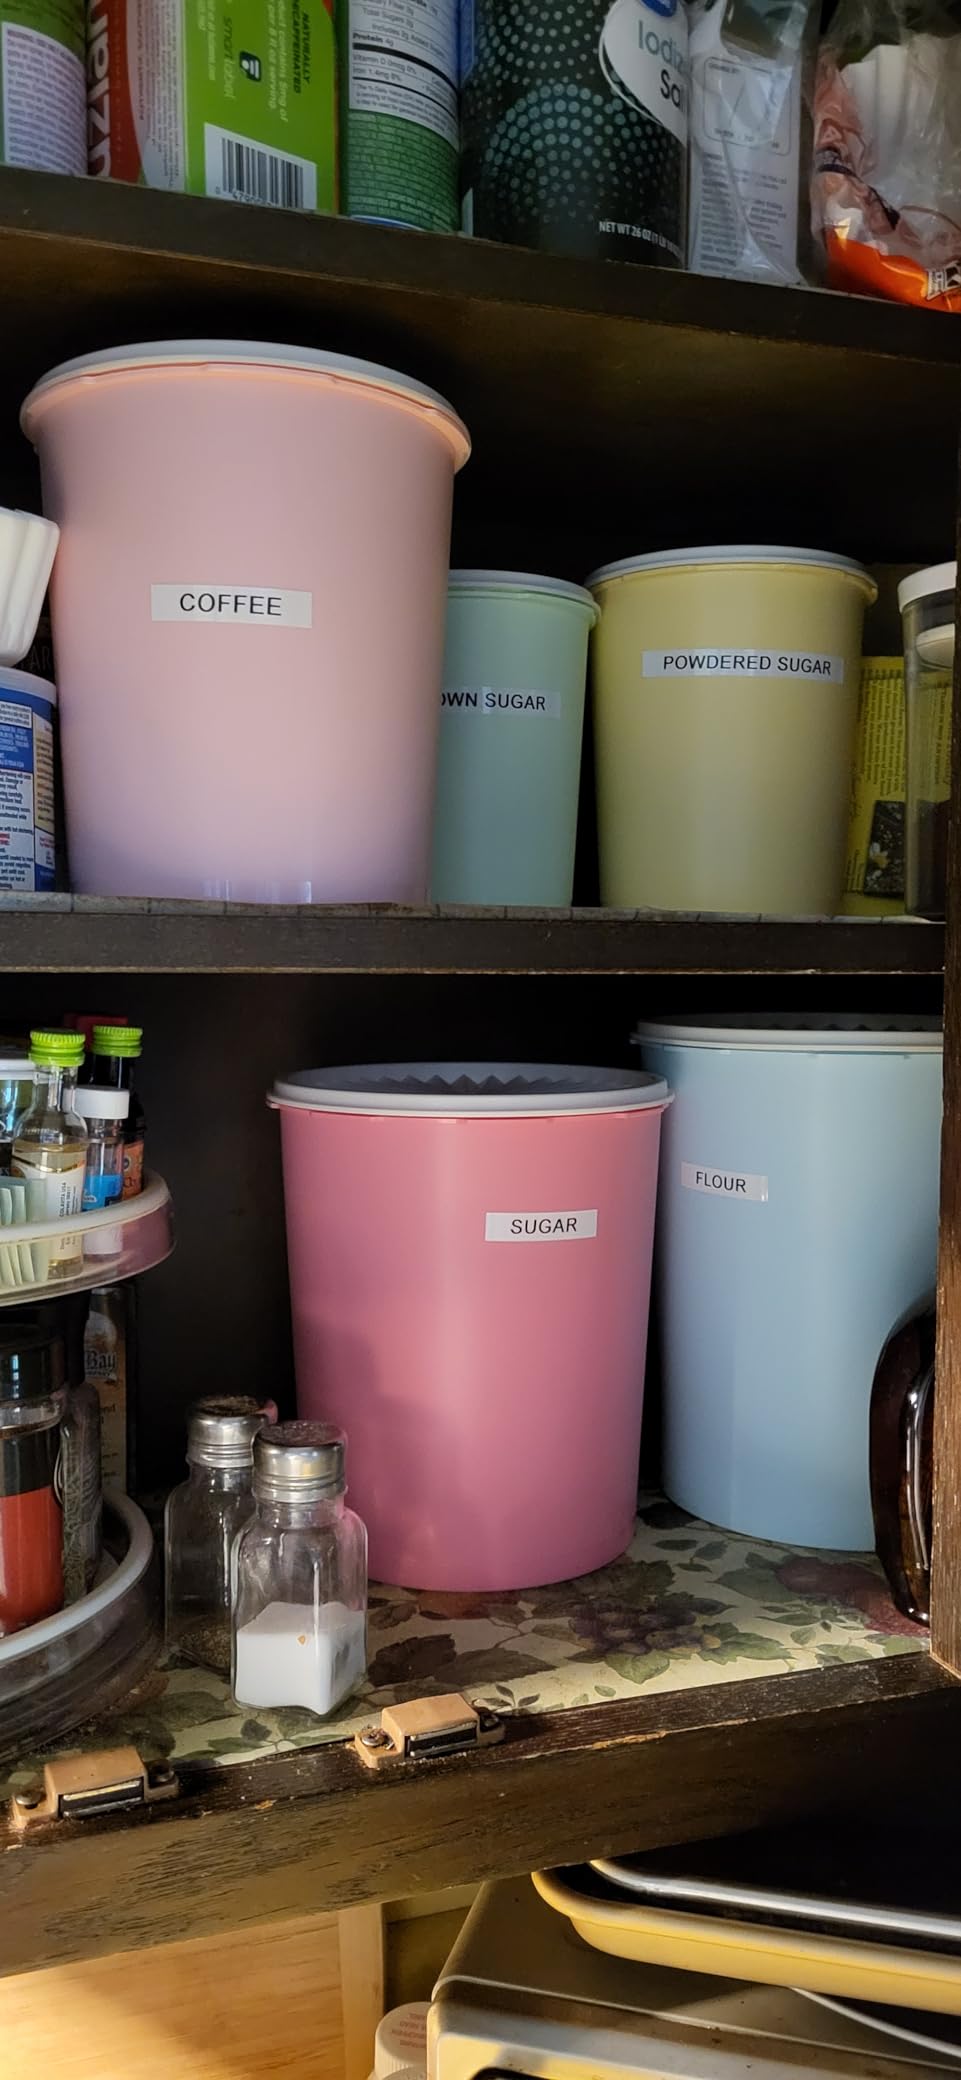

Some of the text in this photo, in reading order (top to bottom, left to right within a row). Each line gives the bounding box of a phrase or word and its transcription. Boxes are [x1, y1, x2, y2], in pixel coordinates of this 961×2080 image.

[302, 11, 311, 84] NATURALLY
[353, 32, 384, 44] Protein
[353, 53, 379, 65] Vitamin
[599, 221, 617, 233] NET
[617, 222, 631, 236] WT
[631, 225, 641, 238] 26
[642, 228, 652, 241] OZ
[179, 592, 283, 616] COFFEE
[663, 655, 832, 676] POWDERED SUGAR
[484, 692, 546, 711] SUGAR
[695, 1171, 746, 1193] FLOUR
[510, 1217, 577, 1235] SUGAR
[86, 1350, 117, 1370] Bay
